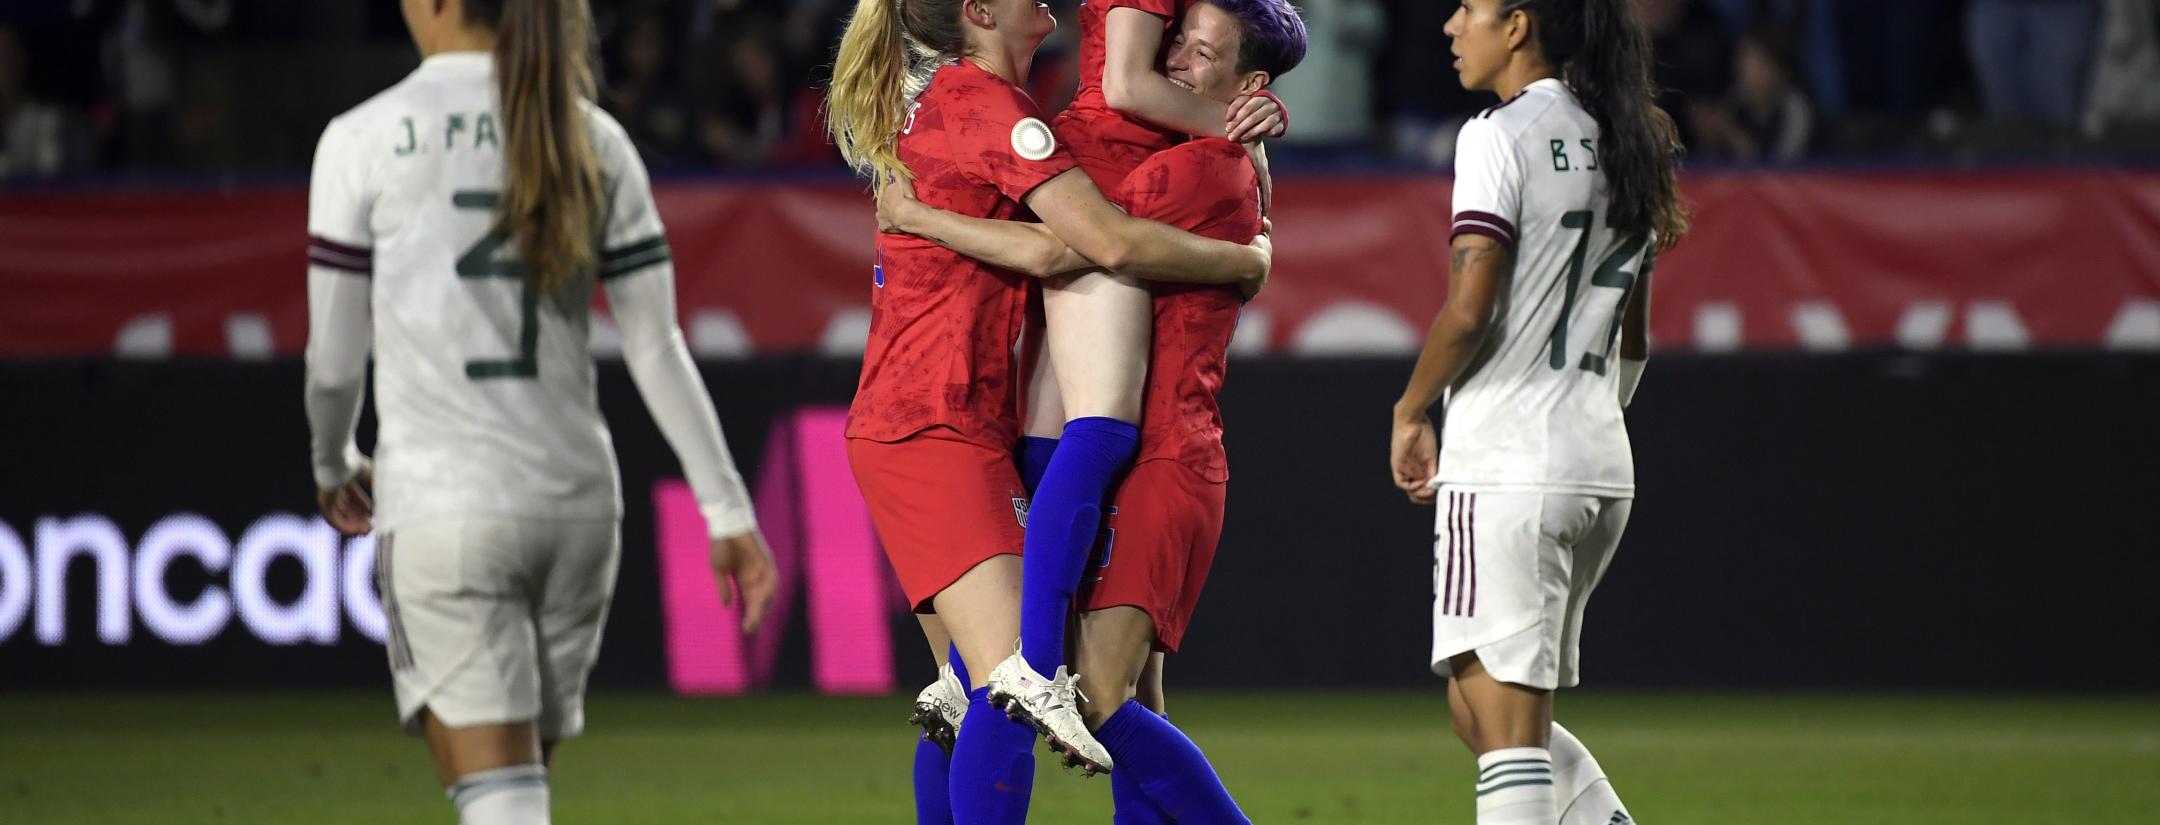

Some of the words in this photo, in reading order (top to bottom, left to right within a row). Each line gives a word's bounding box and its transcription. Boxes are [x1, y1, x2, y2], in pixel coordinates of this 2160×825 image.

[446, 112, 500, 149] PA
[1550, 138, 1599, 172] B.S
[453, 190, 542, 380] 3
[1550, 210, 1650, 377] 13
[932, 696, 962, 720] new
